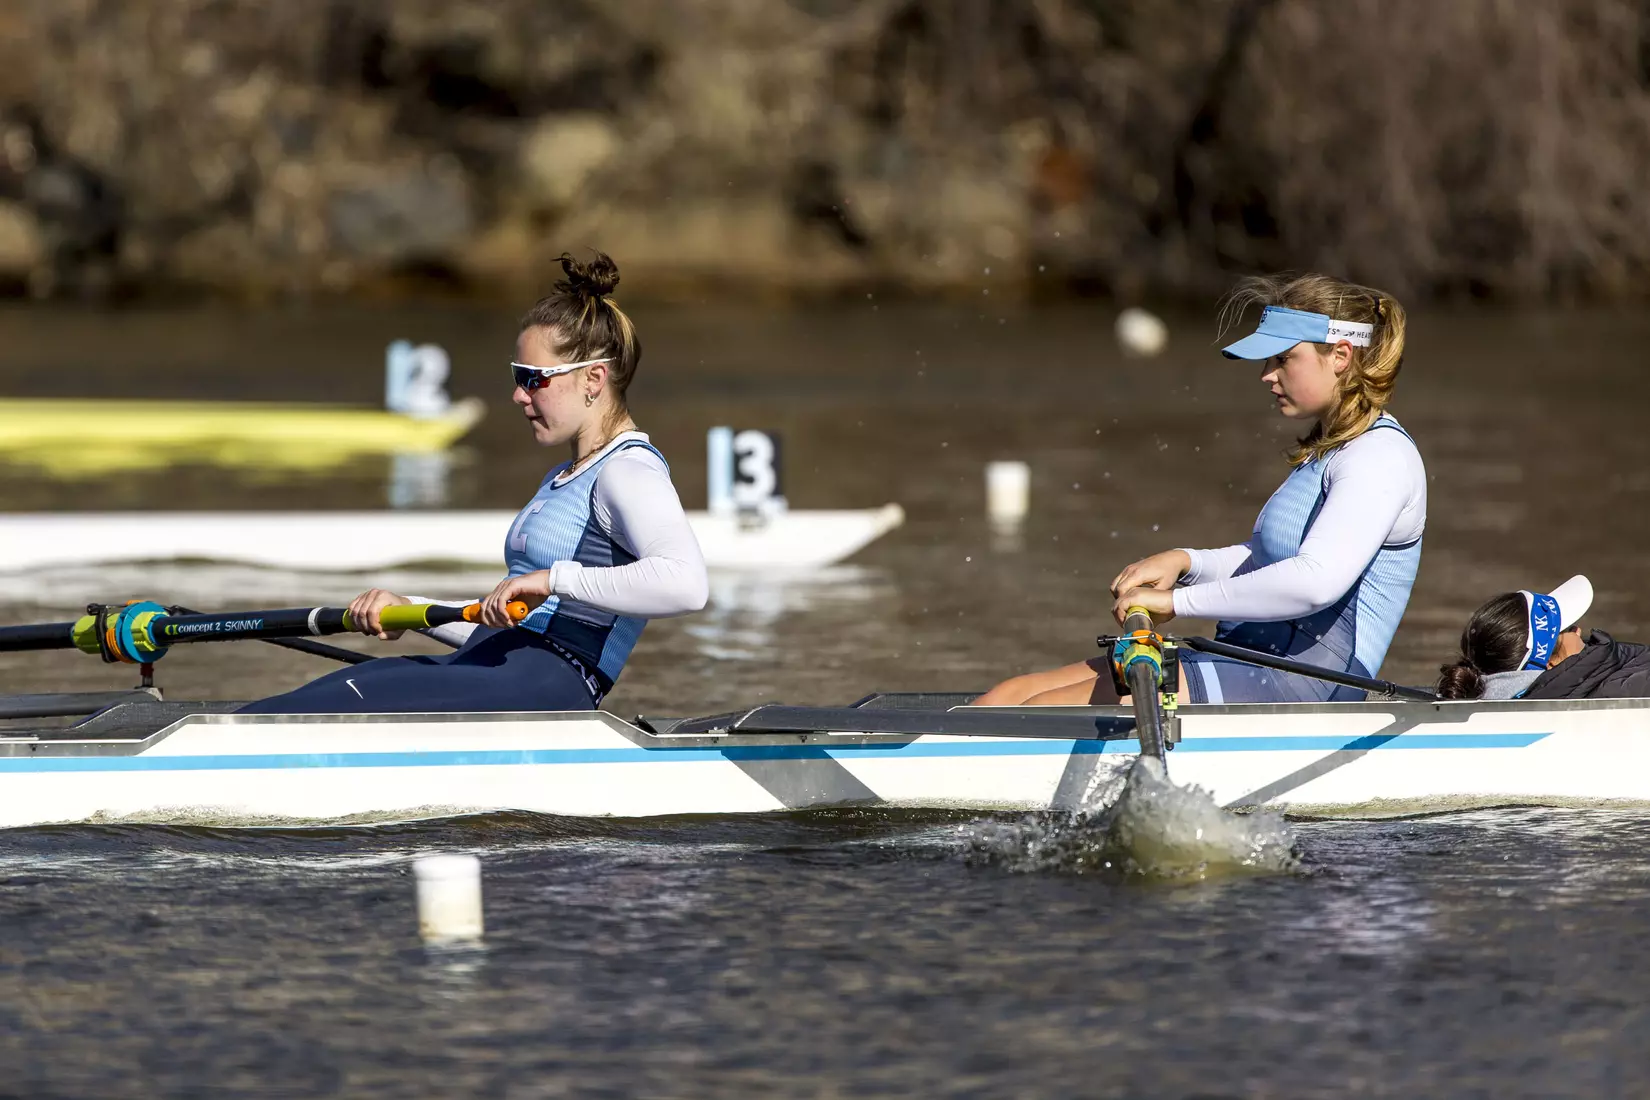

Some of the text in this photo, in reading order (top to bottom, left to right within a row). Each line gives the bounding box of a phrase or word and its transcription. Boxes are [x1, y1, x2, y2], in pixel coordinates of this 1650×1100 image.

[732, 429, 777, 506] 3
[178, 618, 263, 634] concept 2 SKINNY
[1534, 614, 1549, 632] NK
[1534, 641, 1549, 660] NK
